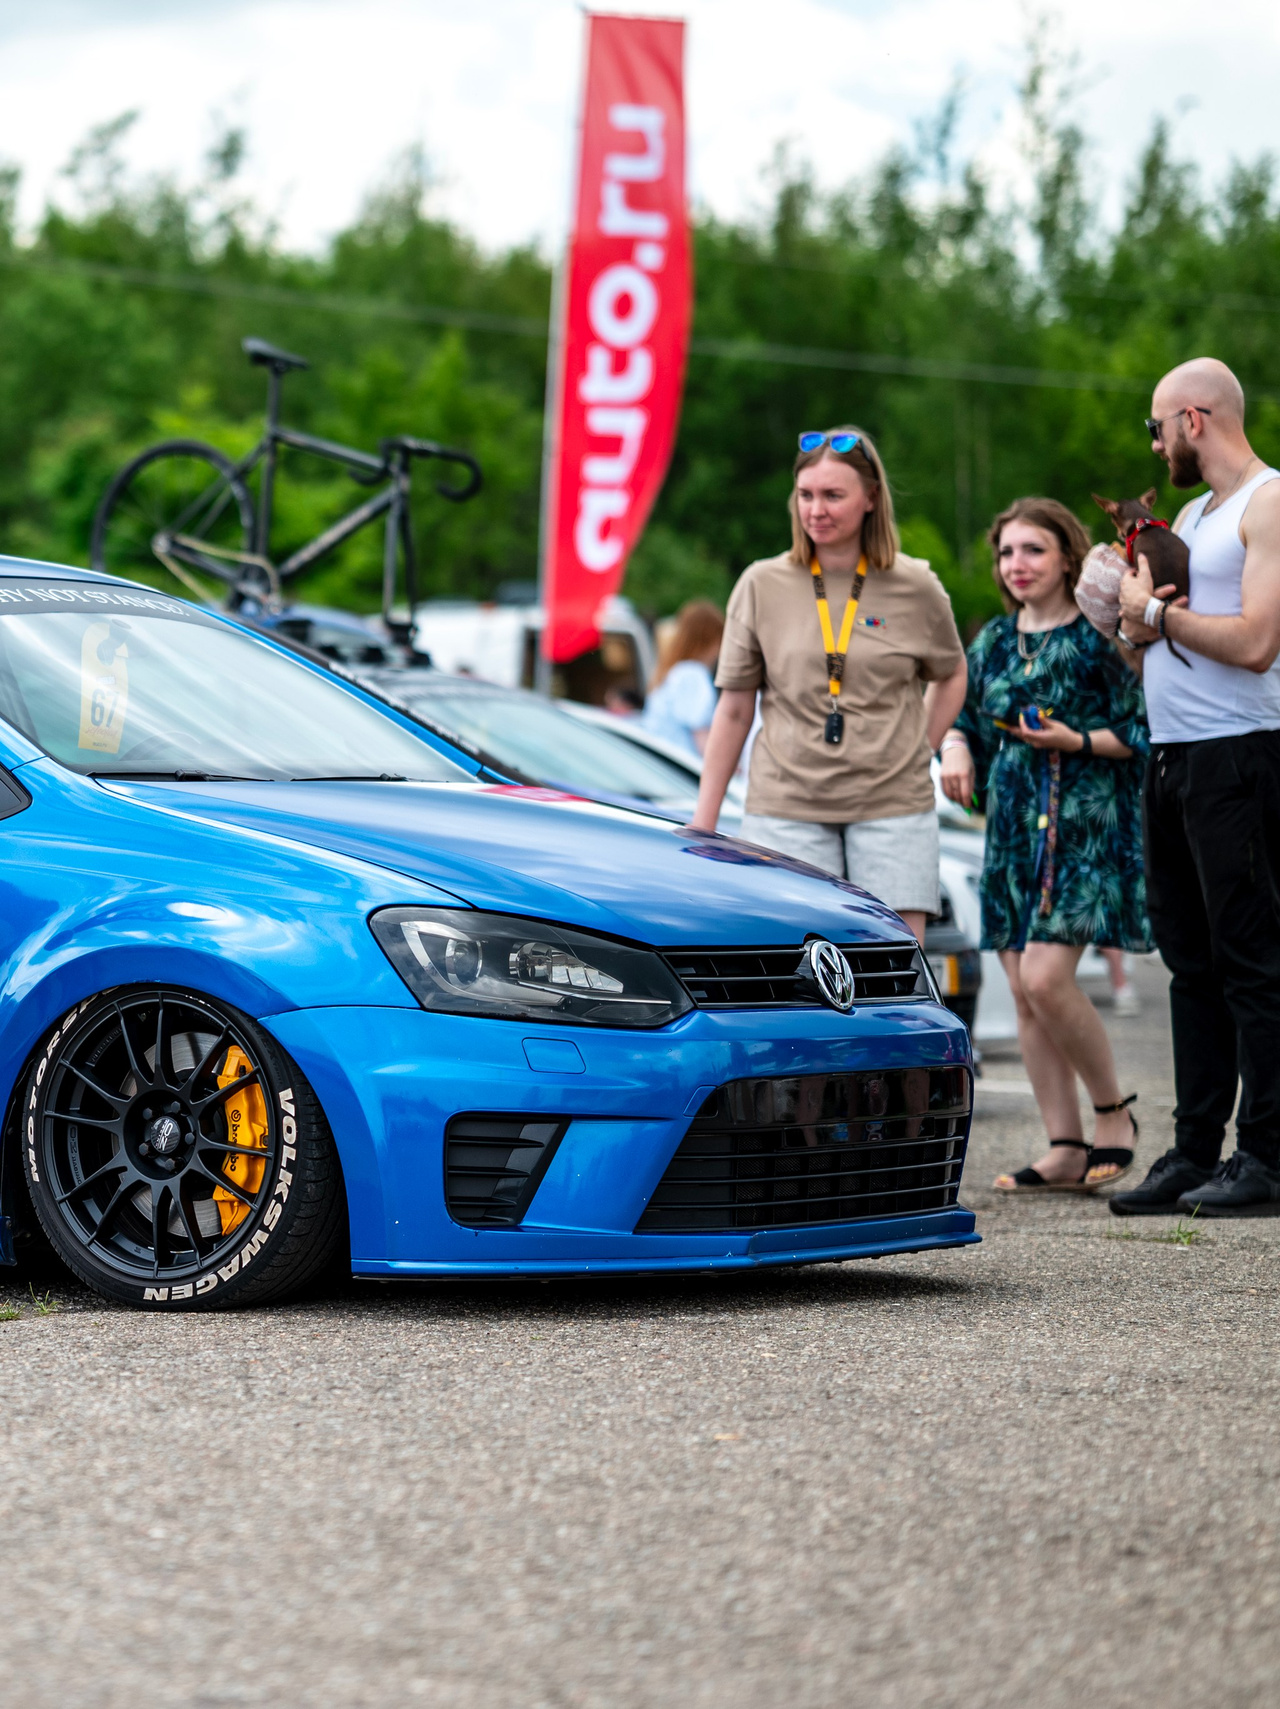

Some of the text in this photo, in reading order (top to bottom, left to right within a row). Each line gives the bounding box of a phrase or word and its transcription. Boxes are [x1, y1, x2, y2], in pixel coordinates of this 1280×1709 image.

[573, 103, 669, 572] auto.ru
[25, 588, 91, 603] NOT
[90, 688, 120, 728] 67
[230, 1123, 241, 1172] brebo
[143, 1088, 297, 1301] VOLKSWAGEN
